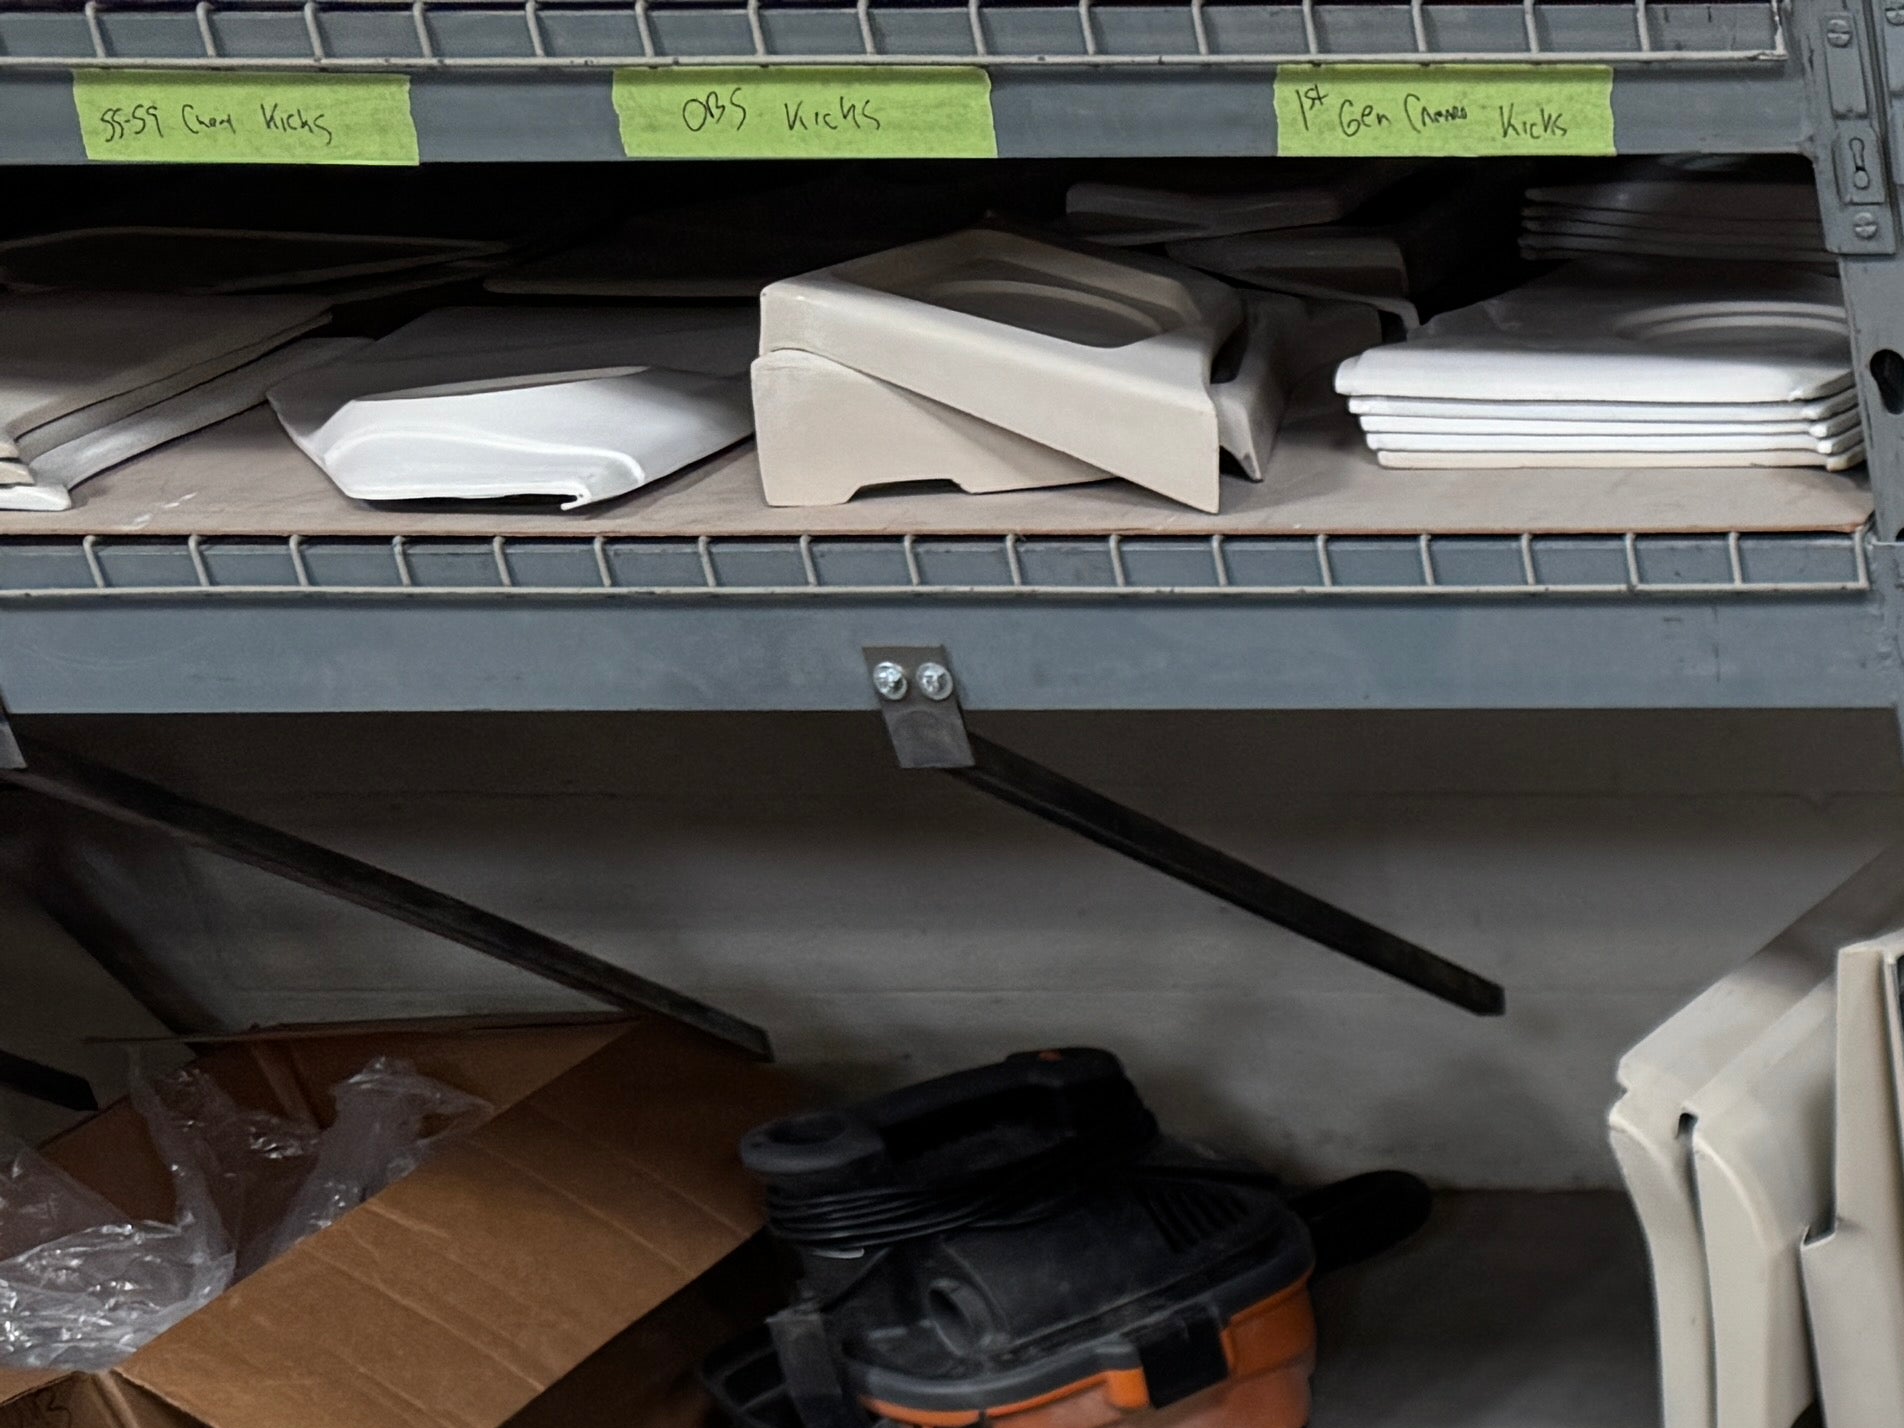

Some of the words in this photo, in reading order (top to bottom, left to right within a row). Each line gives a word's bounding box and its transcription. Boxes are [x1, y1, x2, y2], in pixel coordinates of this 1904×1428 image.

[259, 102, 332, 146] Kicks
[682, 87, 747, 132] OBS
[784, 96, 881, 131] Kicks
[1295, 84, 1330, 132] 1st
[1338, 99, 1392, 138] Gen
[1498, 102, 1568, 140] Kicks
